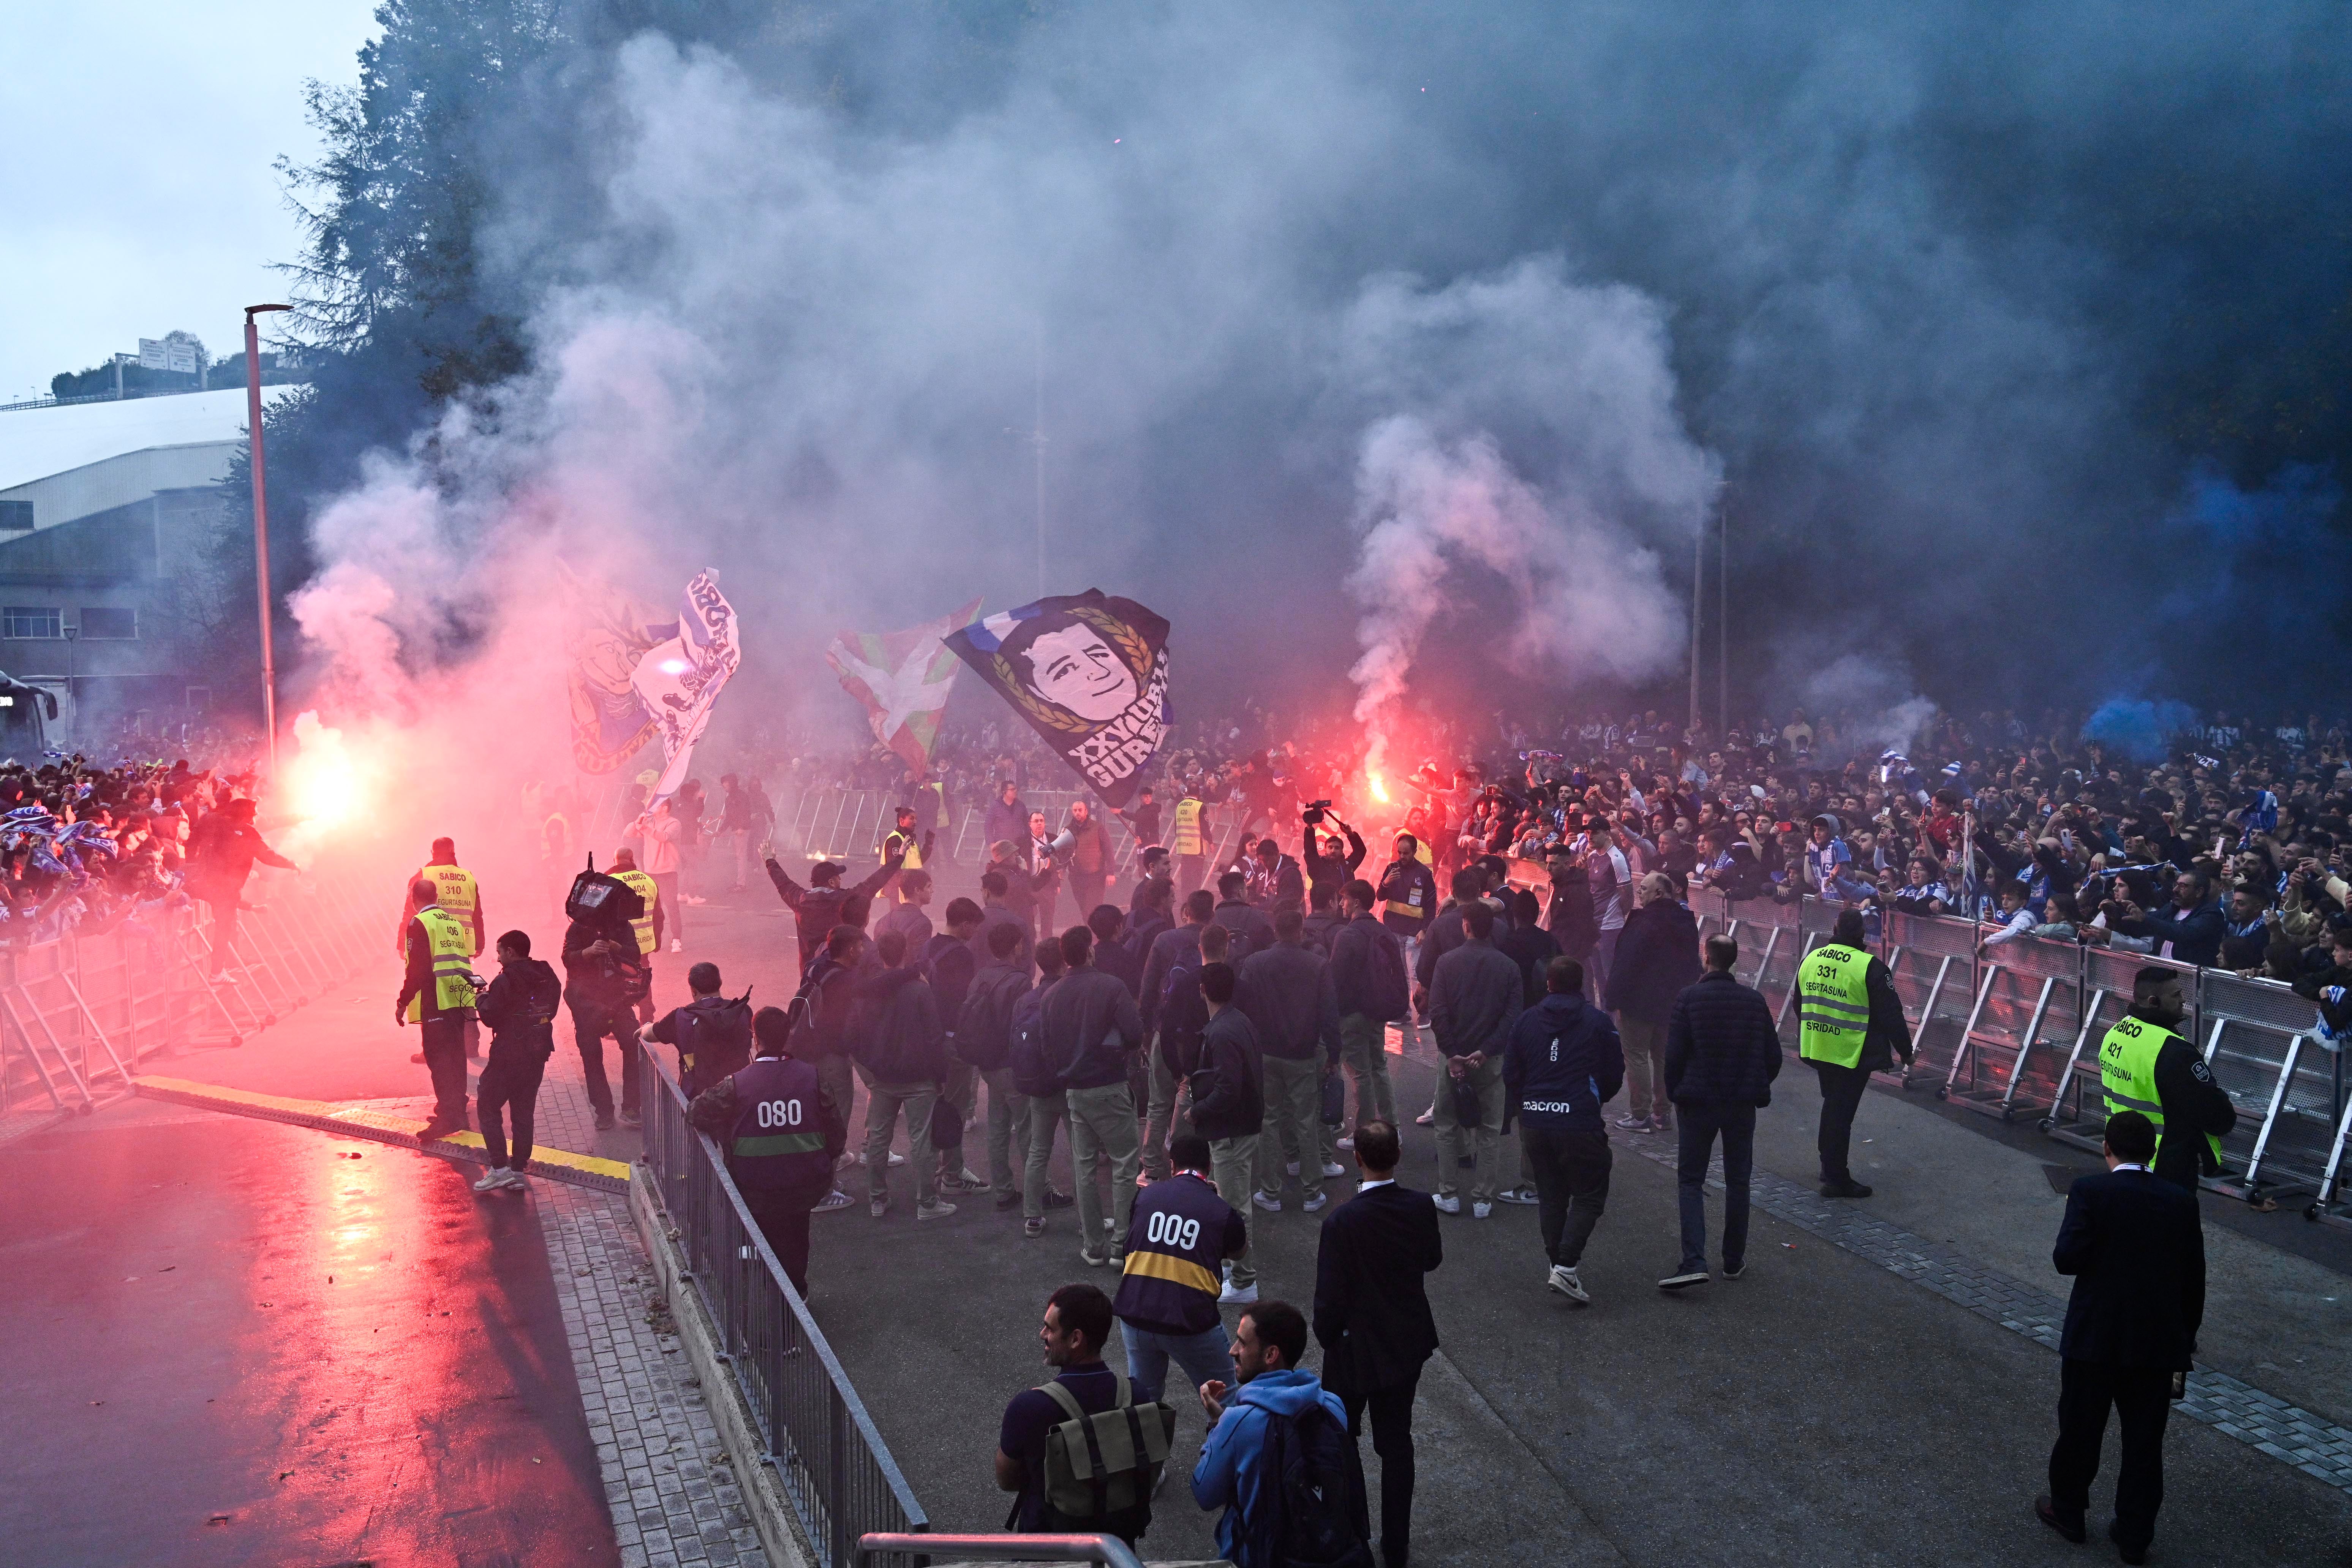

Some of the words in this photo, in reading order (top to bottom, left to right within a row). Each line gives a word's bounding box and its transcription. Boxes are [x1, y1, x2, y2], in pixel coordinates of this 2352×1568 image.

[439, 873, 466, 881] SABICO
[446, 886, 461, 894] 310
[633, 885, 646, 893] 404
[447, 926, 458, 936] 406
[1817, 949, 1851, 963] SABICO
[1817, 965, 1837, 980] 331
[1806, 982, 1848, 999] SEGRTASUNA
[2108, 1042, 2123, 1059] 421
[758, 1099, 801, 1128] 080
[1522, 1101, 1570, 1113] macron
[1148, 1211, 1200, 1250] 009
